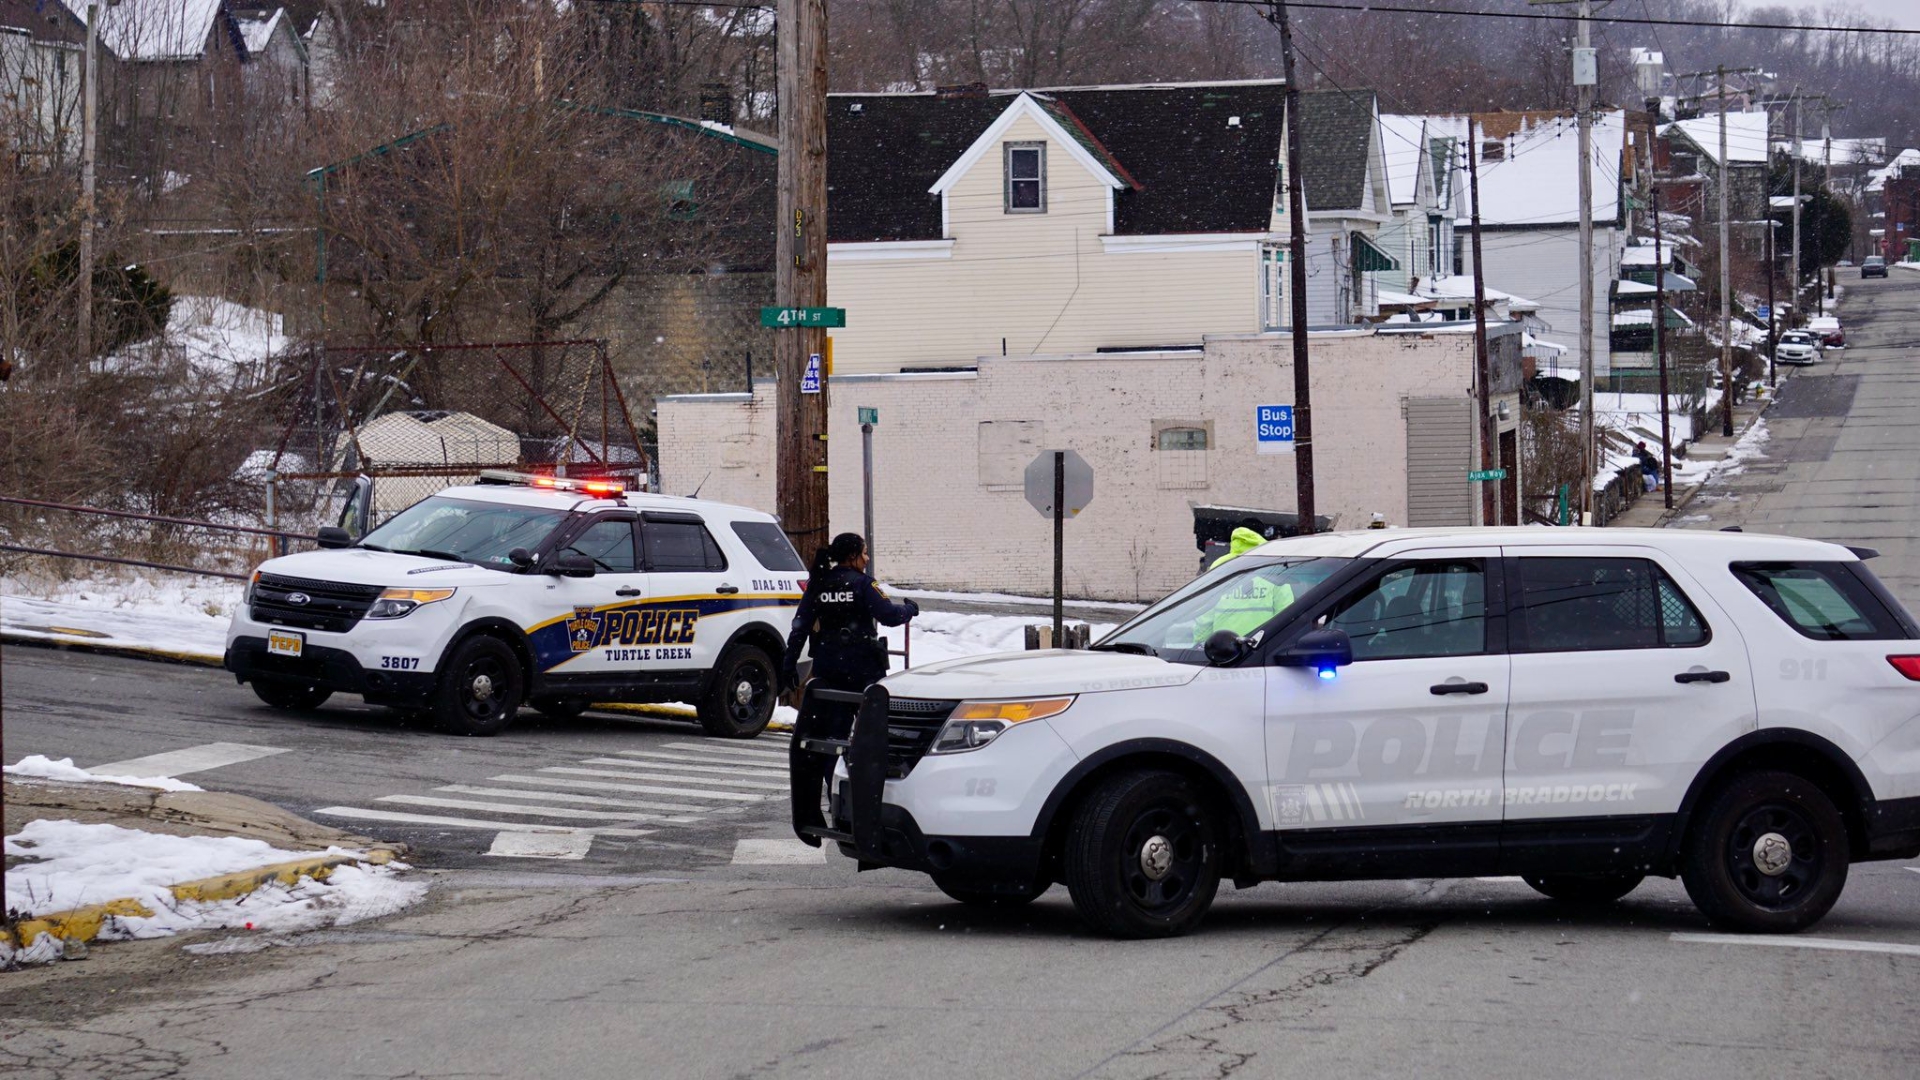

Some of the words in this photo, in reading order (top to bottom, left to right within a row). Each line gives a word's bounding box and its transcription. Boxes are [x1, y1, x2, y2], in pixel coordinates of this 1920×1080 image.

[777, 309, 807, 325] 4TH
[812, 312, 822, 321] ST
[1262, 408, 1287, 421] Bus
[1259, 424, 1291, 438] Stop
[1470, 471, 1486, 480] Ajax
[1489, 469, 1503, 478] Way
[752, 579, 775, 591] DIAL
[776, 579, 792, 591] 911
[820, 591, 854, 604] OLICE
[601, 609, 700, 645] POLICE
[270, 634, 301, 652] TCPD
[572, 640, 590, 650] POLICE
[605, 649, 650, 661] TURTLE
[655, 648, 692, 660] CREEK
[381, 656, 420, 670] 3807
[1779, 658, 1828, 681] 911
[1080, 681, 1102, 692] TO
[1109, 674, 1186, 690] PROTECT
[1208, 669, 1263, 682] SERVE
[1285, 709, 1636, 780] POLICE
[965, 777, 997, 797] 18
[1404, 788, 1492, 809] NORTH
[1499, 782, 1638, 805] BRADDOCK
